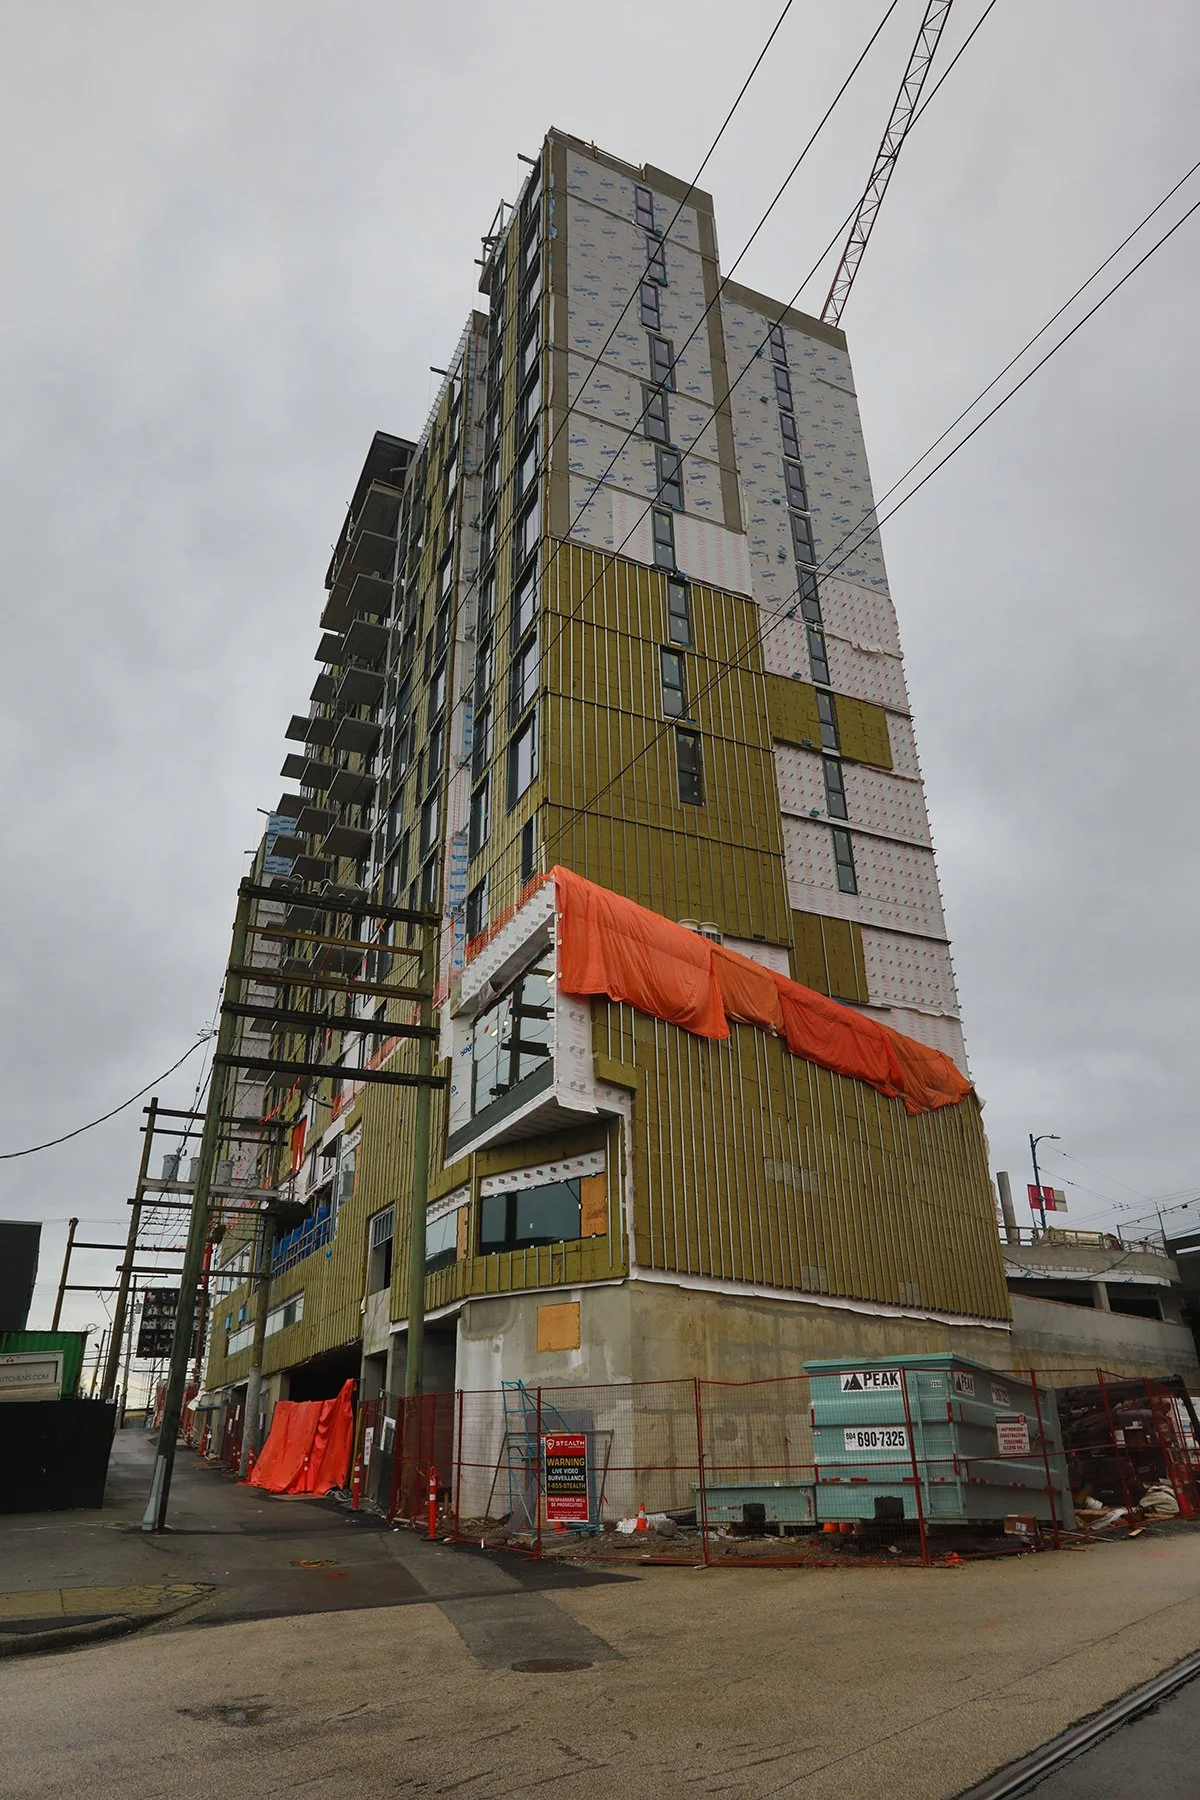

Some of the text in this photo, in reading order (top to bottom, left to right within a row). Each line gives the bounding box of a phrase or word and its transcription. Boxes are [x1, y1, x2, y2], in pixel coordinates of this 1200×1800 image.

[863, 1372, 899, 1386] PEAK
[846, 1432, 856, 1440] 604
[857, 1431, 905, 1447] 690-7325
[547, 1458, 585, 1466] WARNING
